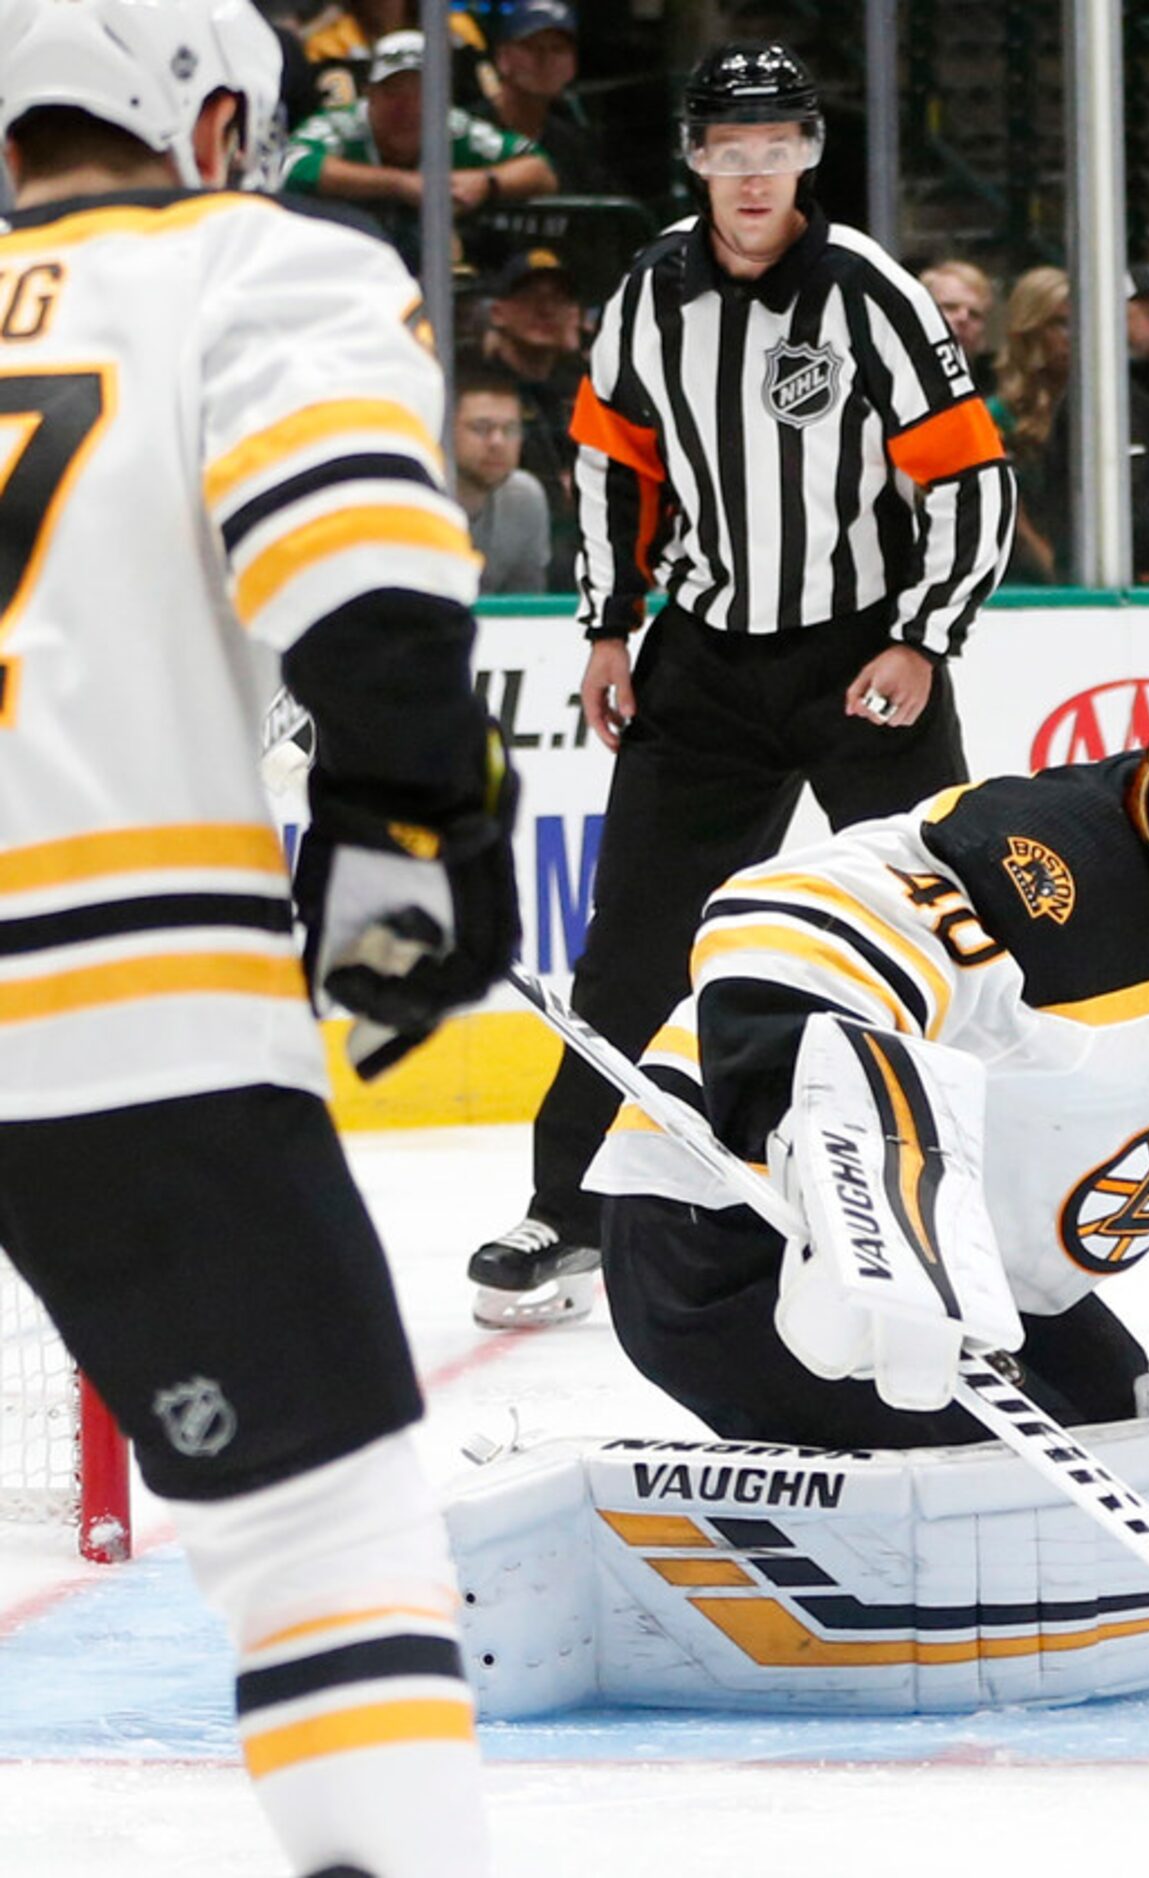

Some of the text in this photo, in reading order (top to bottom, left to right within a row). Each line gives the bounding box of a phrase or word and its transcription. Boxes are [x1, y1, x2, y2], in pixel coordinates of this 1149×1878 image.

[0, 263, 63, 342] G
[778, 366, 827, 408] NHL
[884, 862, 1010, 969] 40
[1010, 838, 1072, 921] BOSTON
[821, 1129, 893, 1281] VAUGHN
[633, 1462, 846, 1509] VAUGHN
